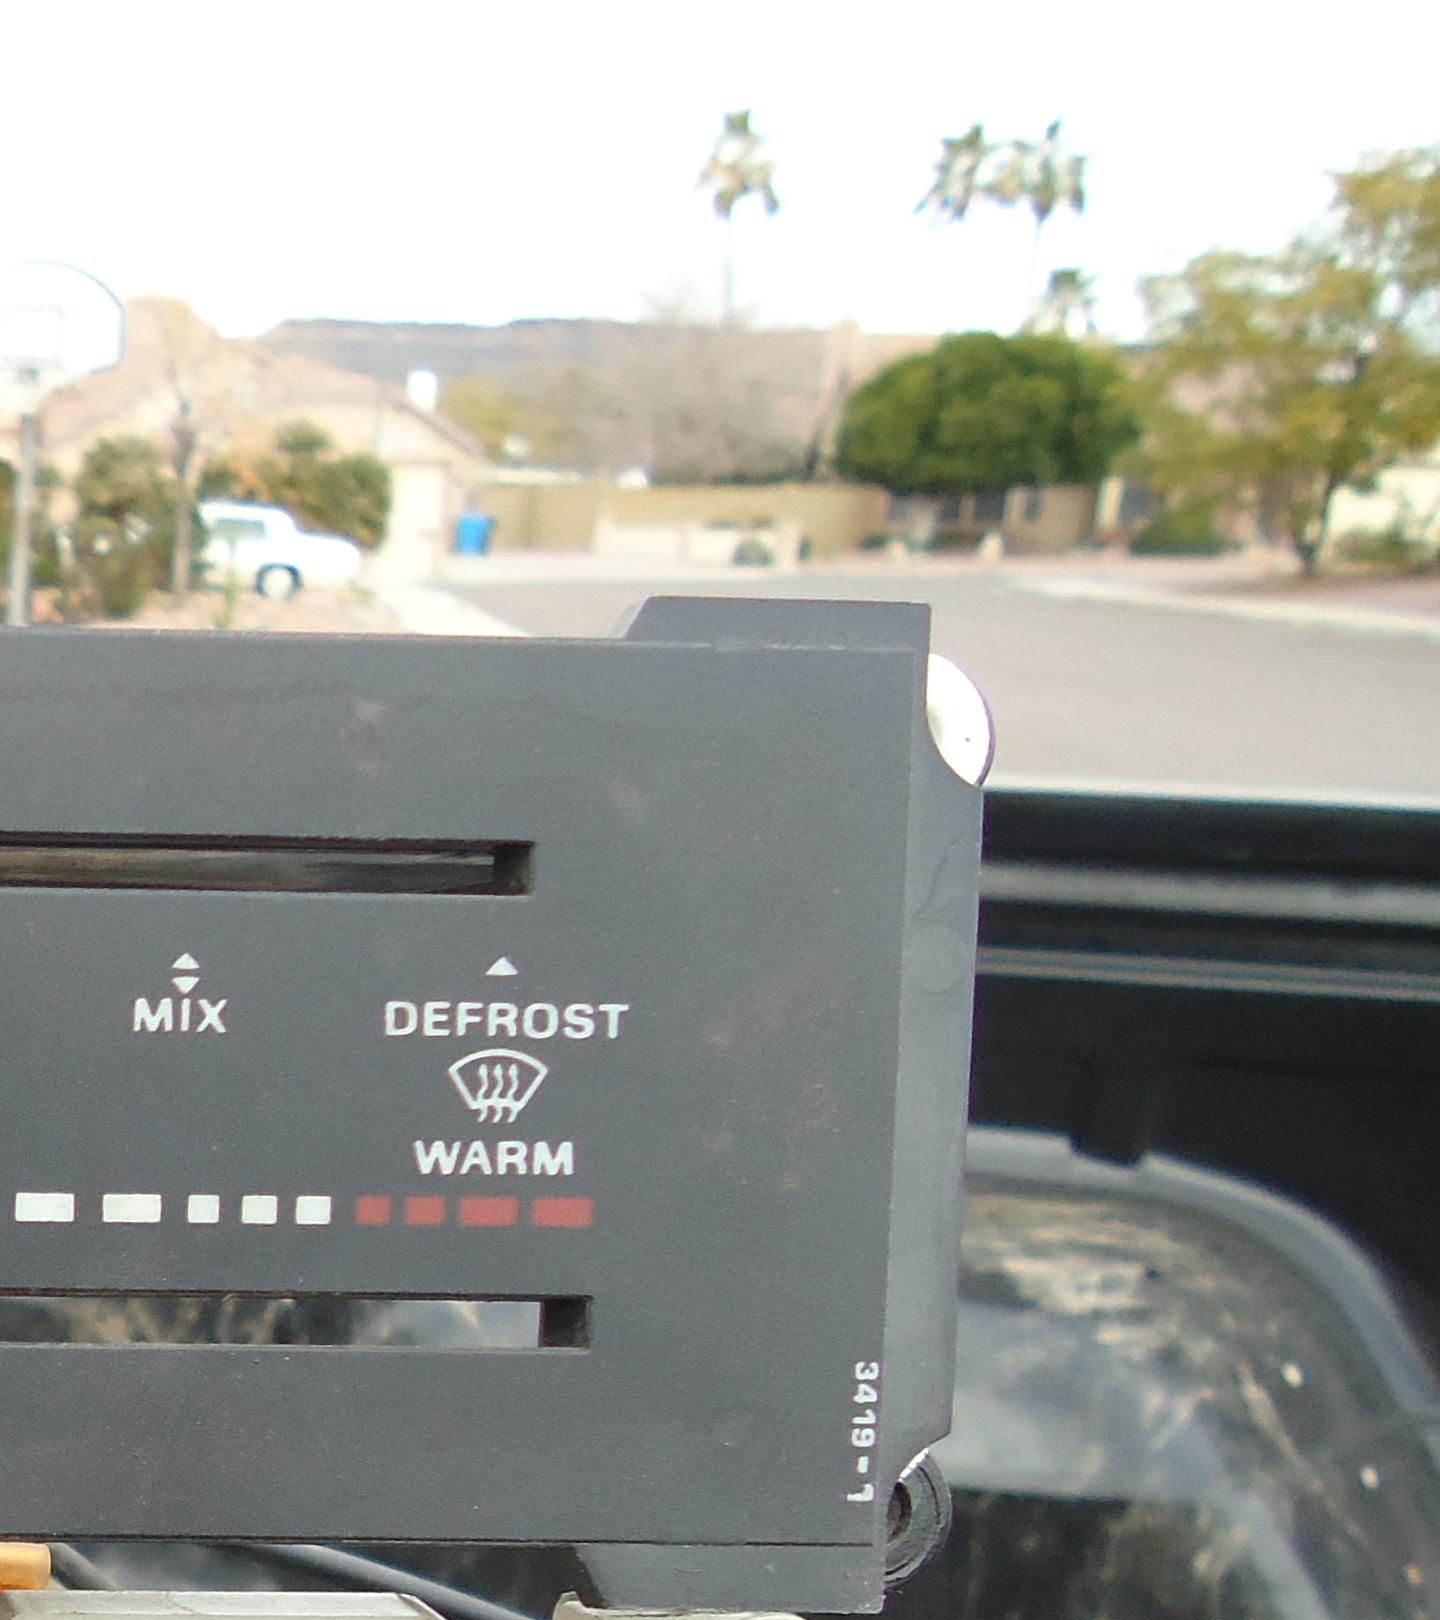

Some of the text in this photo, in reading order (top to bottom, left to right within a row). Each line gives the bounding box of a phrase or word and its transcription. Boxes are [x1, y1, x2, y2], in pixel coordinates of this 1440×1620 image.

[134, 998, 227, 1033] MIX
[386, 1001, 629, 1039] DEFROST
[415, 1141, 573, 1175] WARM
[847, 1362, 879, 1501] 3419-1
